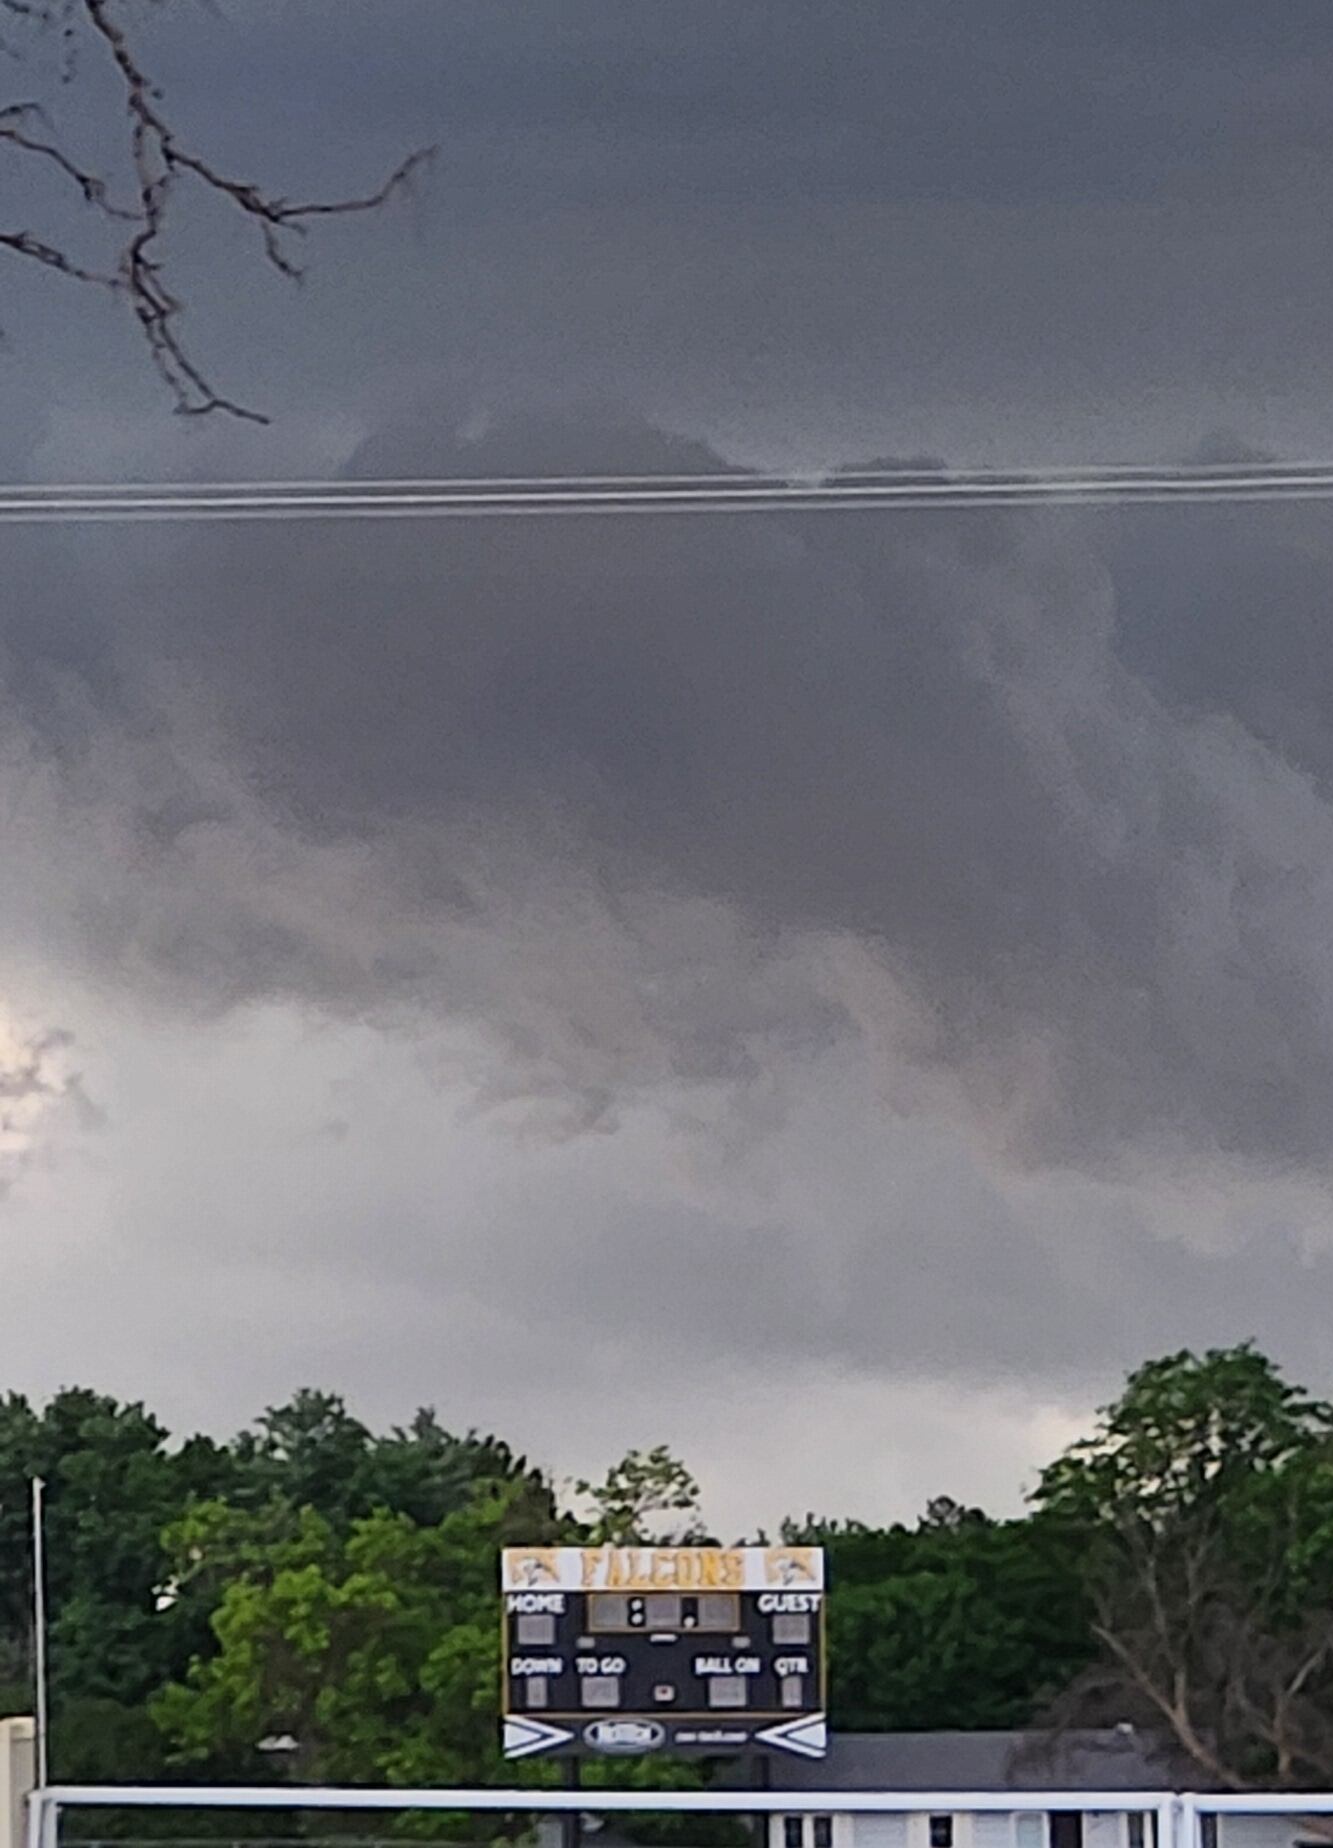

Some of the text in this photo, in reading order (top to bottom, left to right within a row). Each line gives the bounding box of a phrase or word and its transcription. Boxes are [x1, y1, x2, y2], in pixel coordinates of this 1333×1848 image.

[581, 1552, 744, 1586] FALCONS
[507, 1594, 565, 1613] HOME
[758, 1594, 821, 1613] GUEST
[511, 1658, 563, 1675] DOWN
[576, 1658, 626, 1674] TO GO
[695, 1658, 761, 1674] BALL ON
[774, 1658, 809, 1675] QTR
